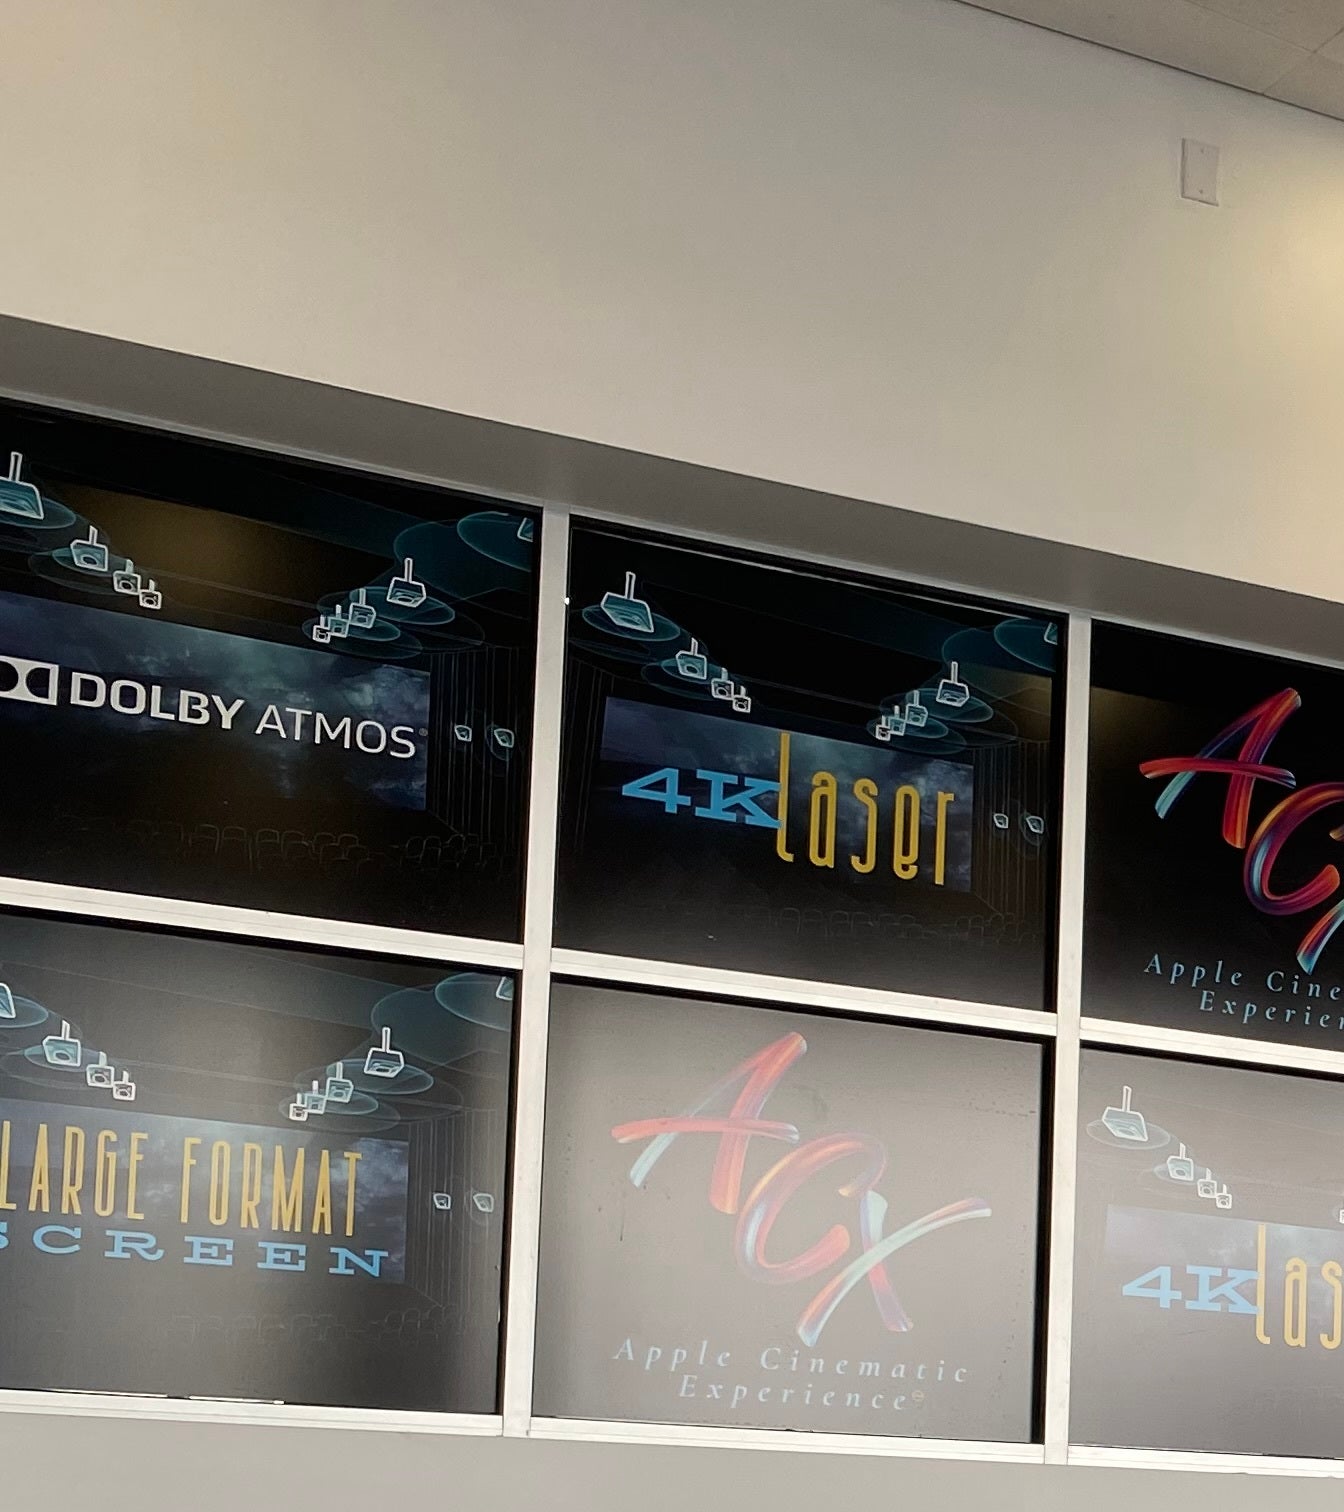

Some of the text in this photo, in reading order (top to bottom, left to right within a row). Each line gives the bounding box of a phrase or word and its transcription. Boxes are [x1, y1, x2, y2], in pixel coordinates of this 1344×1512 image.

[70, 672, 416, 759] DOLBY ATMOS
[621, 732, 955, 886] 4K laser
[1144, 953, 1243, 988] Apple
[0, 1120, 363, 1237] LARGE FORMAT
[611, 1031, 992, 1348] ACX
[0, 1221, 389, 1278] CREEN
[1122, 1264, 1260, 1315] 4K
[612, 1338, 969, 1383] Apple Cinematic
[679, 1374, 907, 1411] Experience
